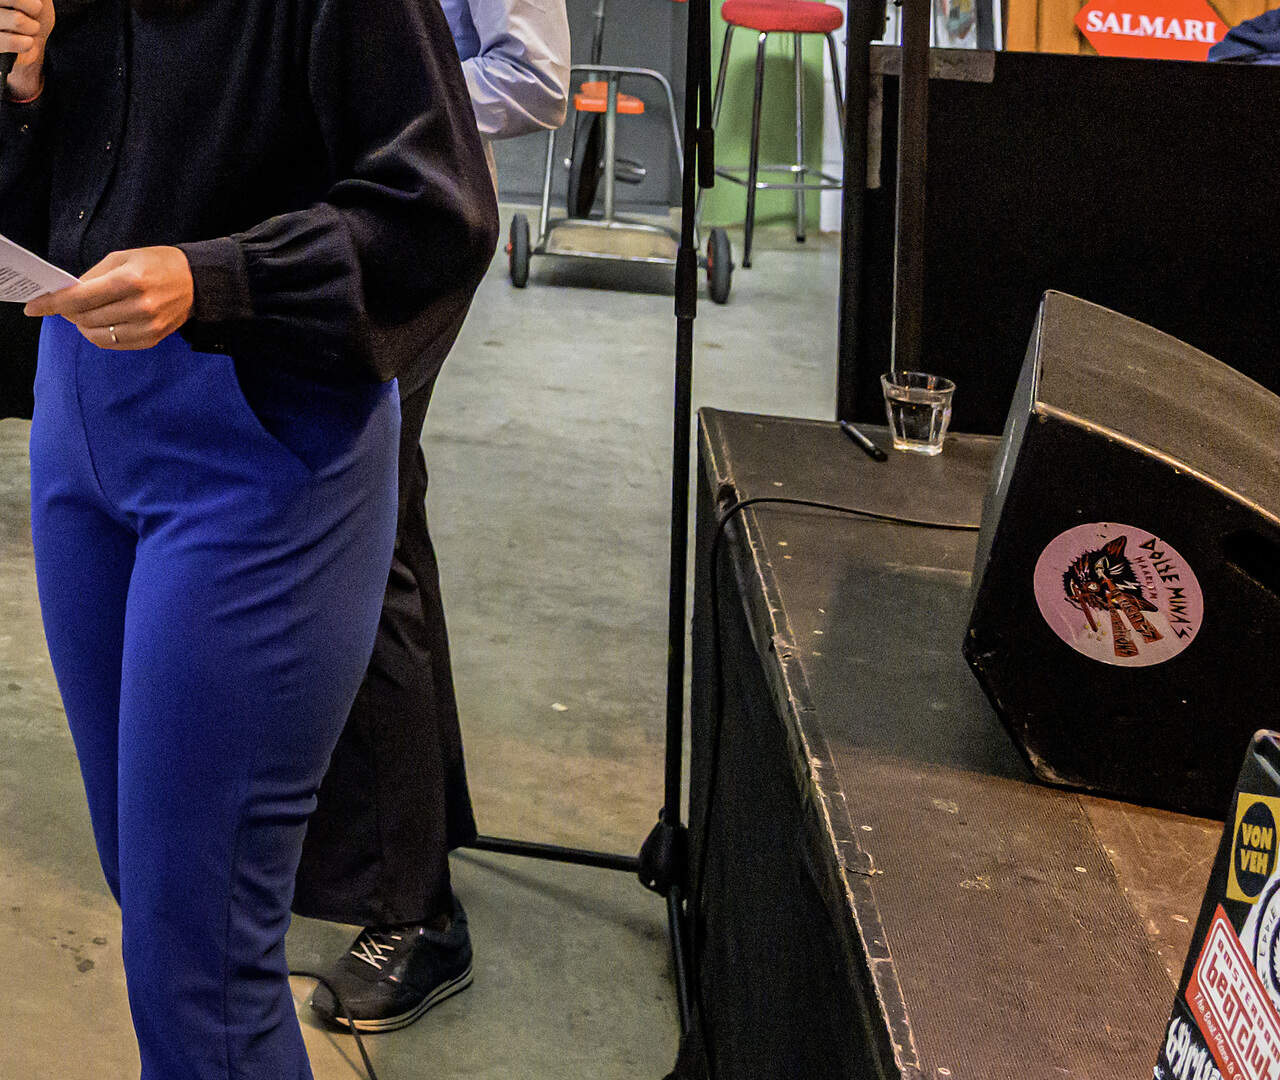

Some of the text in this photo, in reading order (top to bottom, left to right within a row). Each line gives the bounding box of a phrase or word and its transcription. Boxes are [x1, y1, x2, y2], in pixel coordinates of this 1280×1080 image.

[1086, 9, 1217, 45] SALMARI
[1241, 822, 1273, 850] VON
[1240, 848, 1269, 876] VEH
